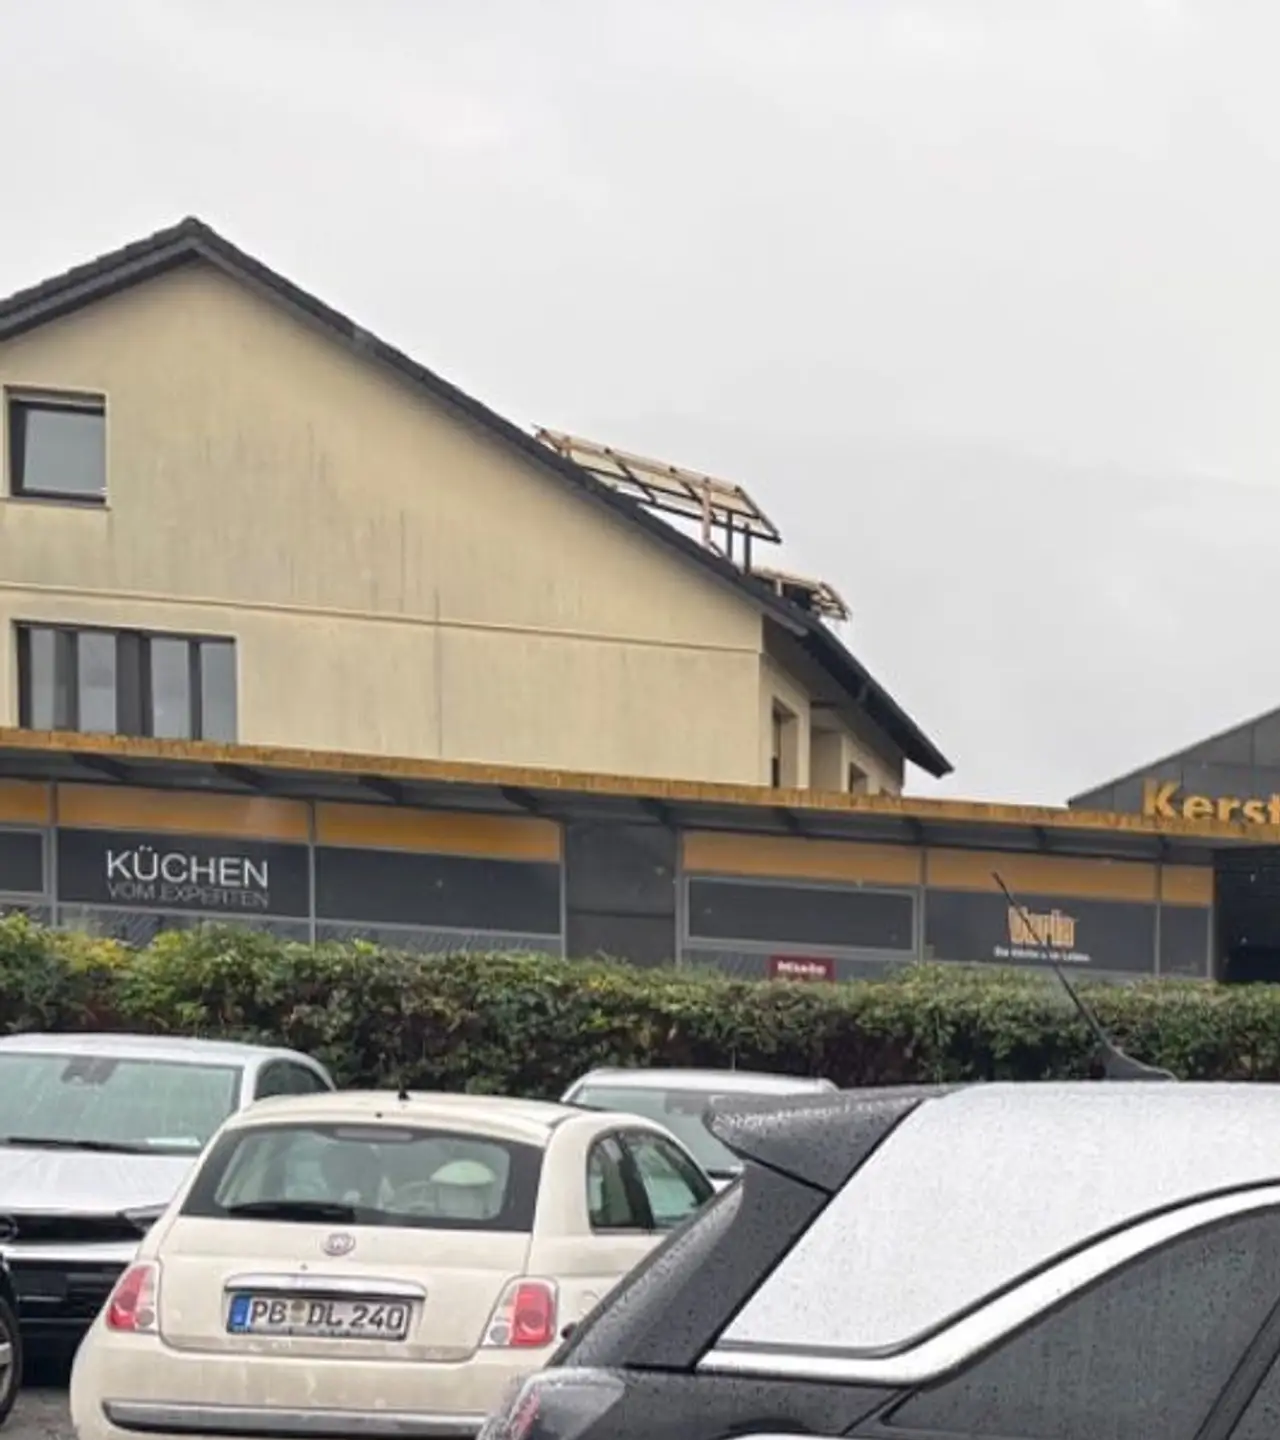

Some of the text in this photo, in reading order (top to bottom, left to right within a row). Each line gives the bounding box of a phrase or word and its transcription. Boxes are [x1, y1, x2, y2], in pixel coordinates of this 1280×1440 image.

[106, 844, 269, 889] KÜCHEN
[251, 1301, 404, 1331] PB DL 240
